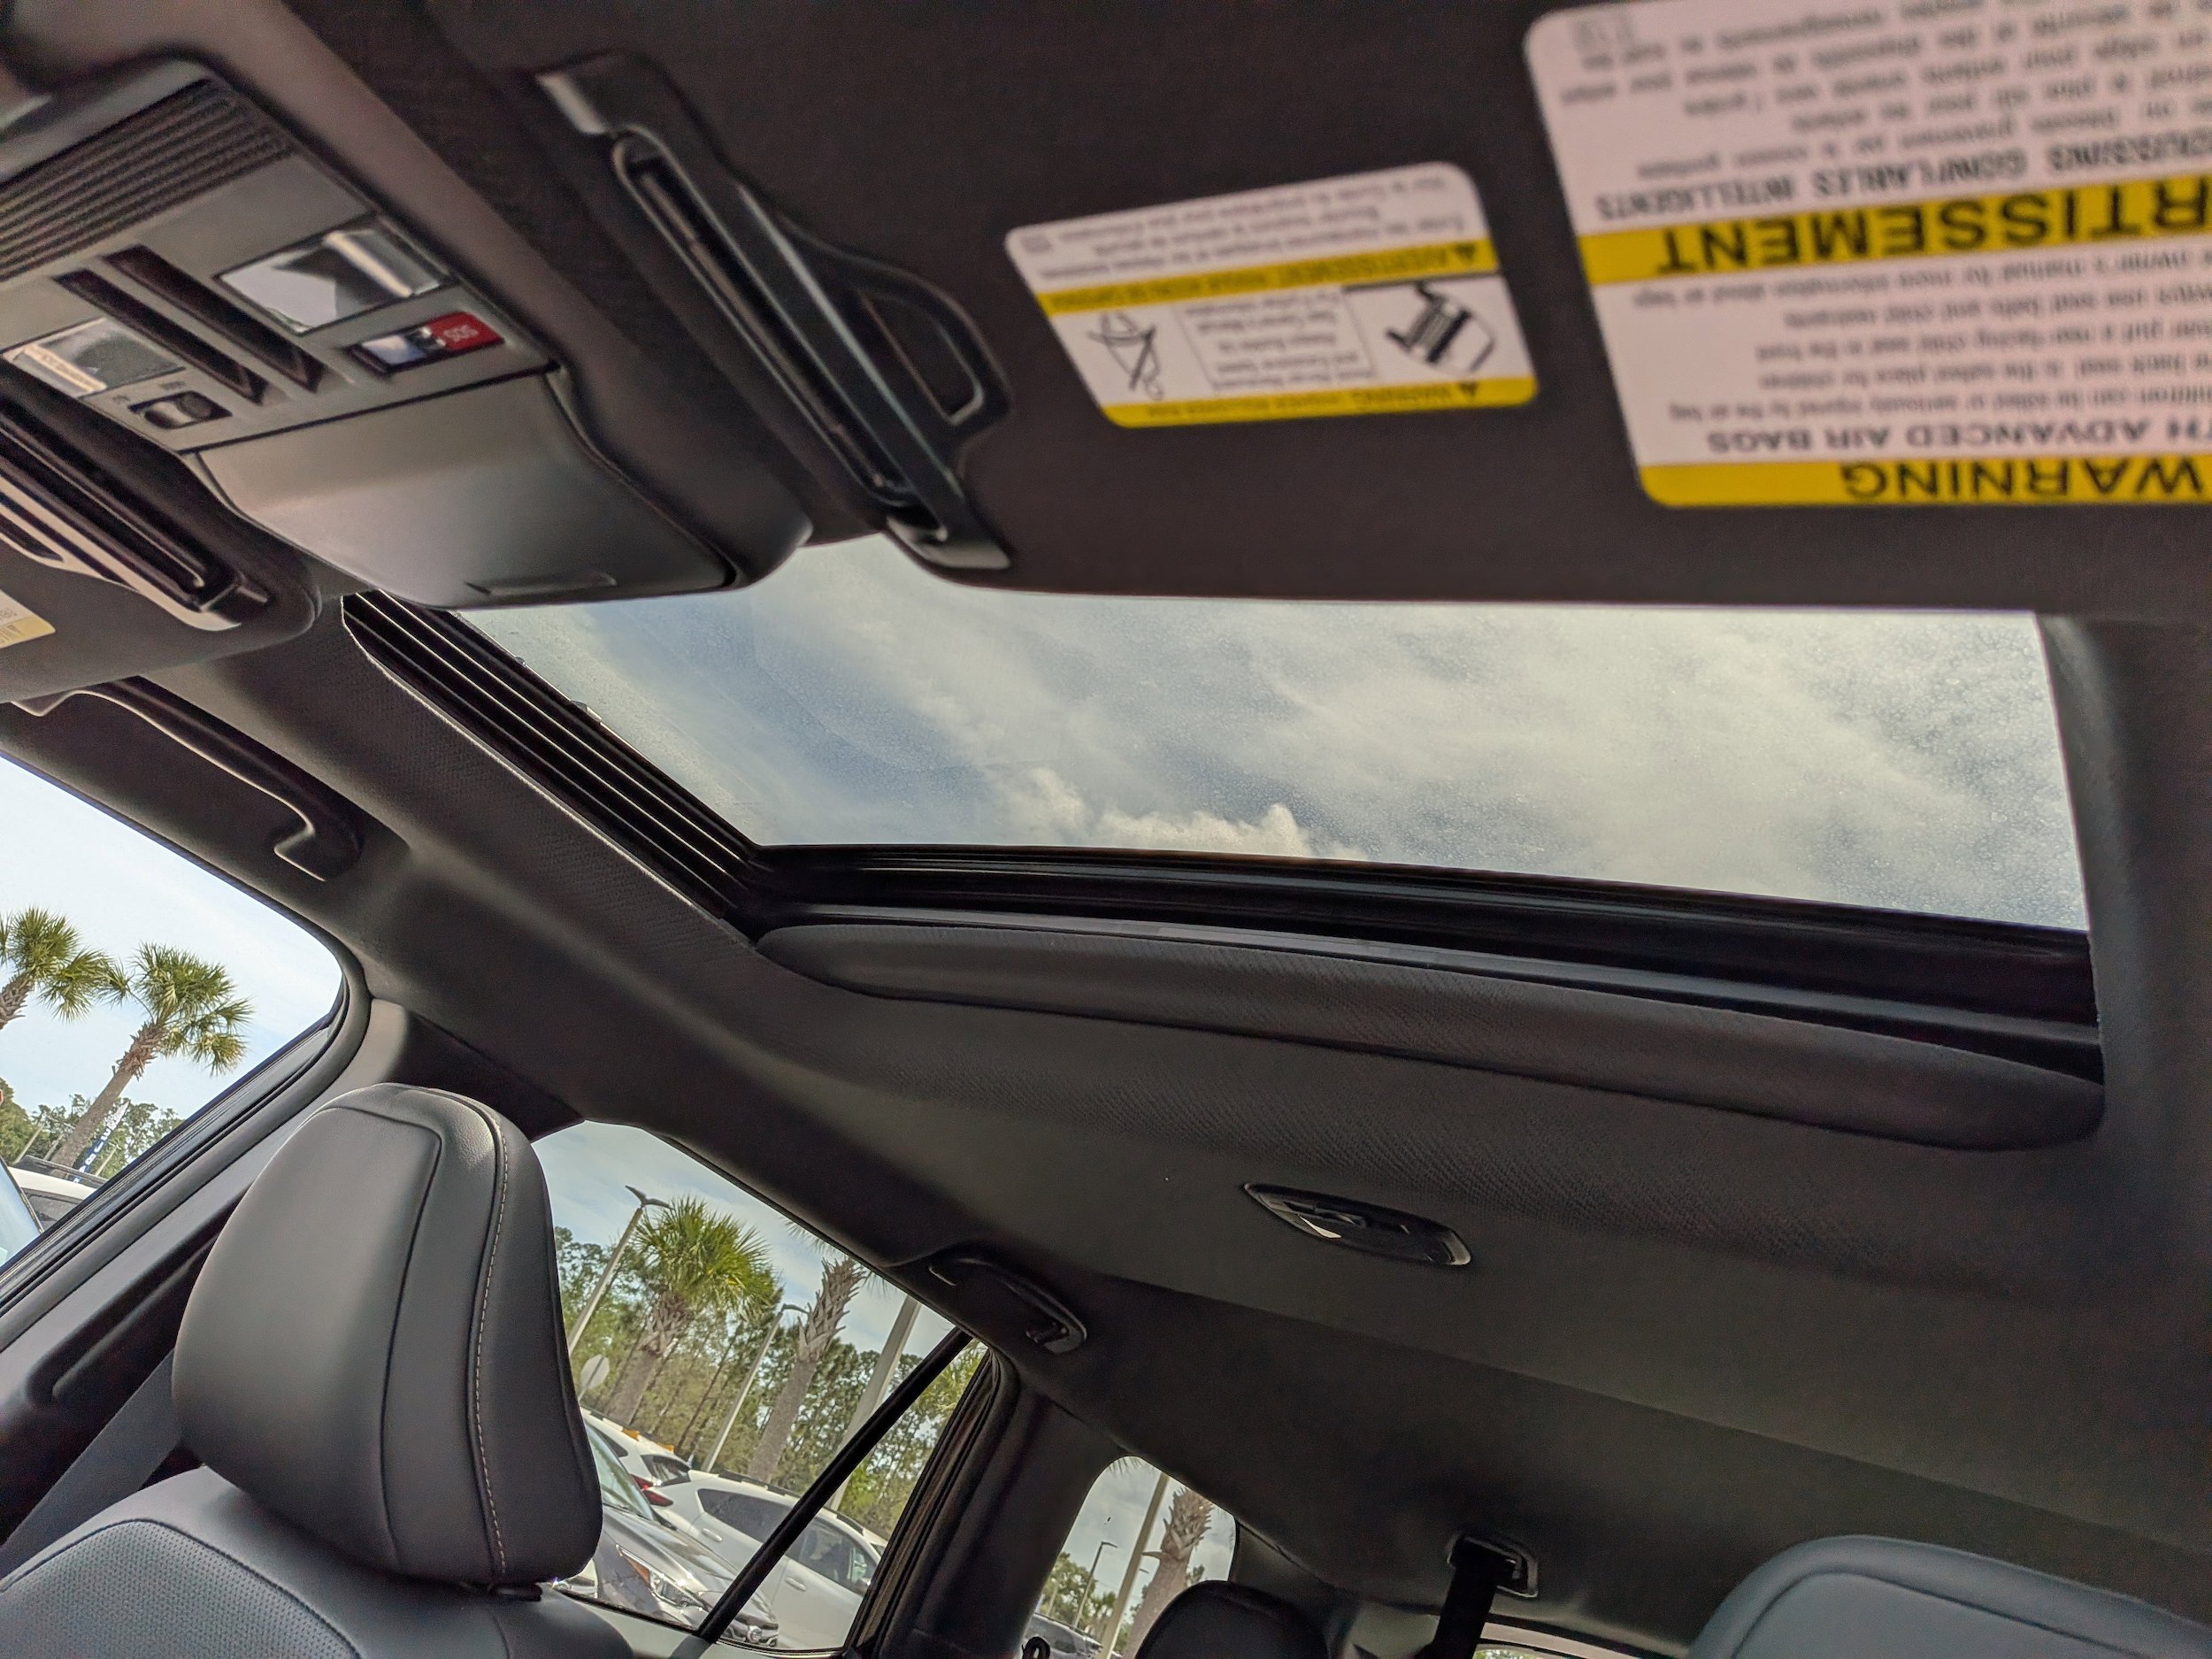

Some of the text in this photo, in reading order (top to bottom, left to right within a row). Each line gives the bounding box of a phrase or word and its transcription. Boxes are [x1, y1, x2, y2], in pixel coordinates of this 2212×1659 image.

[1707, 428, 1812, 452] BAGS
[1824, 426, 1888, 449] AIR
[1905, 419, 2148, 448] ADVANCED
[1839, 457, 2202, 498] WARNING
